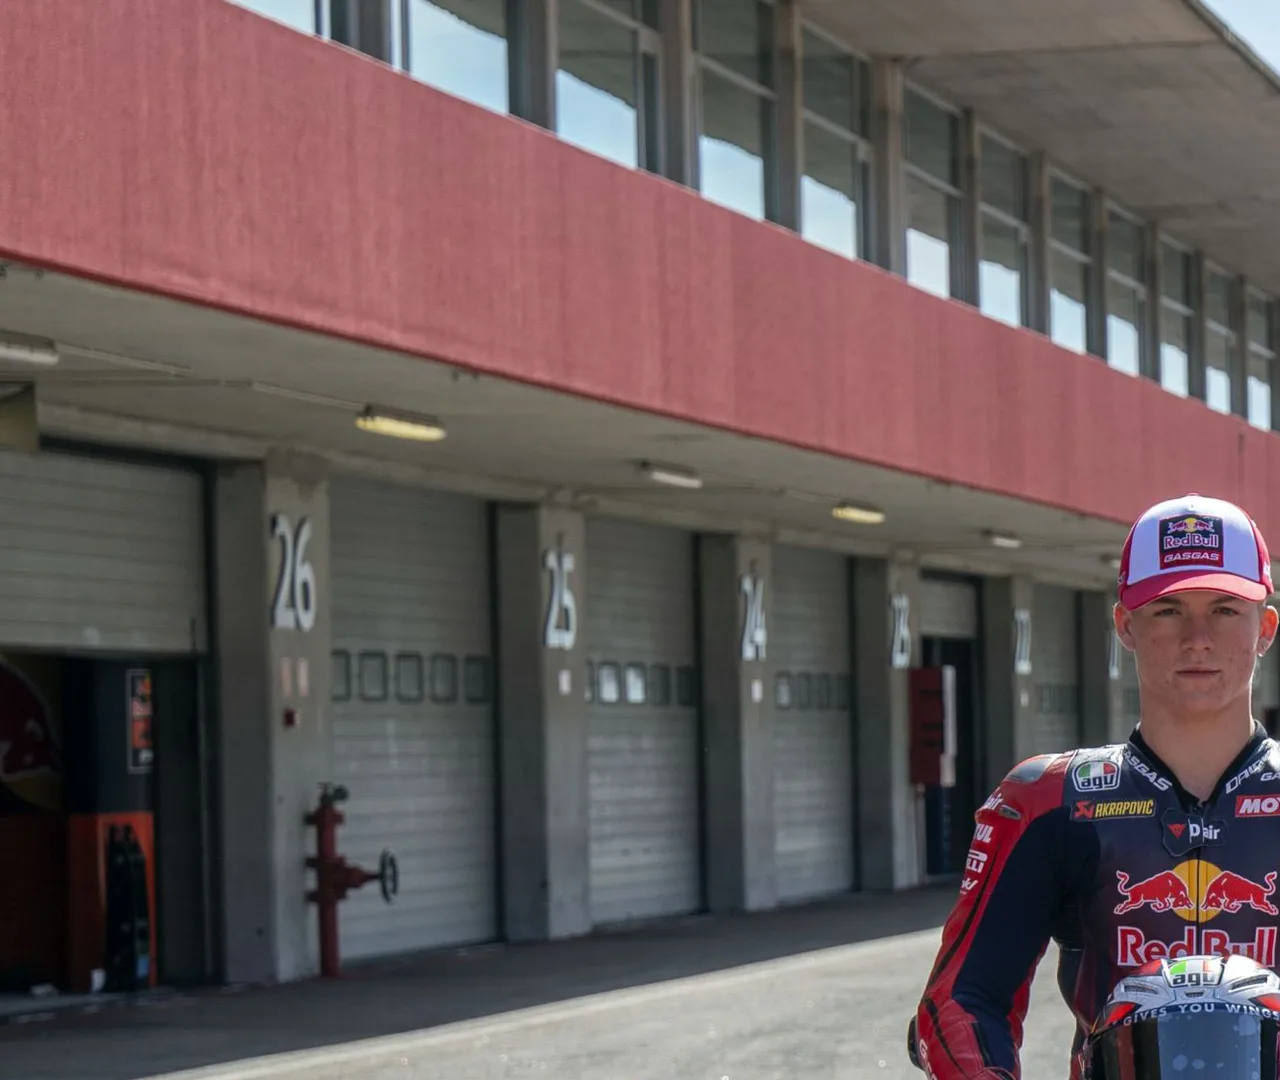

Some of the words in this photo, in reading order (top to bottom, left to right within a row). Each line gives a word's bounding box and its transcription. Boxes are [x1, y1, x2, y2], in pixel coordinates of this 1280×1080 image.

[1163, 533, 1191, 549] Red
[1191, 533, 1219, 548] Bull
[1164, 552, 1219, 563] GASGAS
[271, 511, 316, 632] 26
[542, 548, 577, 650] 25
[739, 573, 767, 662] 24
[1081, 774, 1115, 789] agv
[1123, 750, 1172, 792] ASGAS
[1117, 925, 1197, 967] Red
[1201, 926, 1278, 967] Bull
[1172, 972, 1216, 986] agv
[1123, 1005, 1168, 1027] GIVES
[1177, 1002, 1216, 1014] YOU
[1225, 1003, 1280, 1021] WINGS
